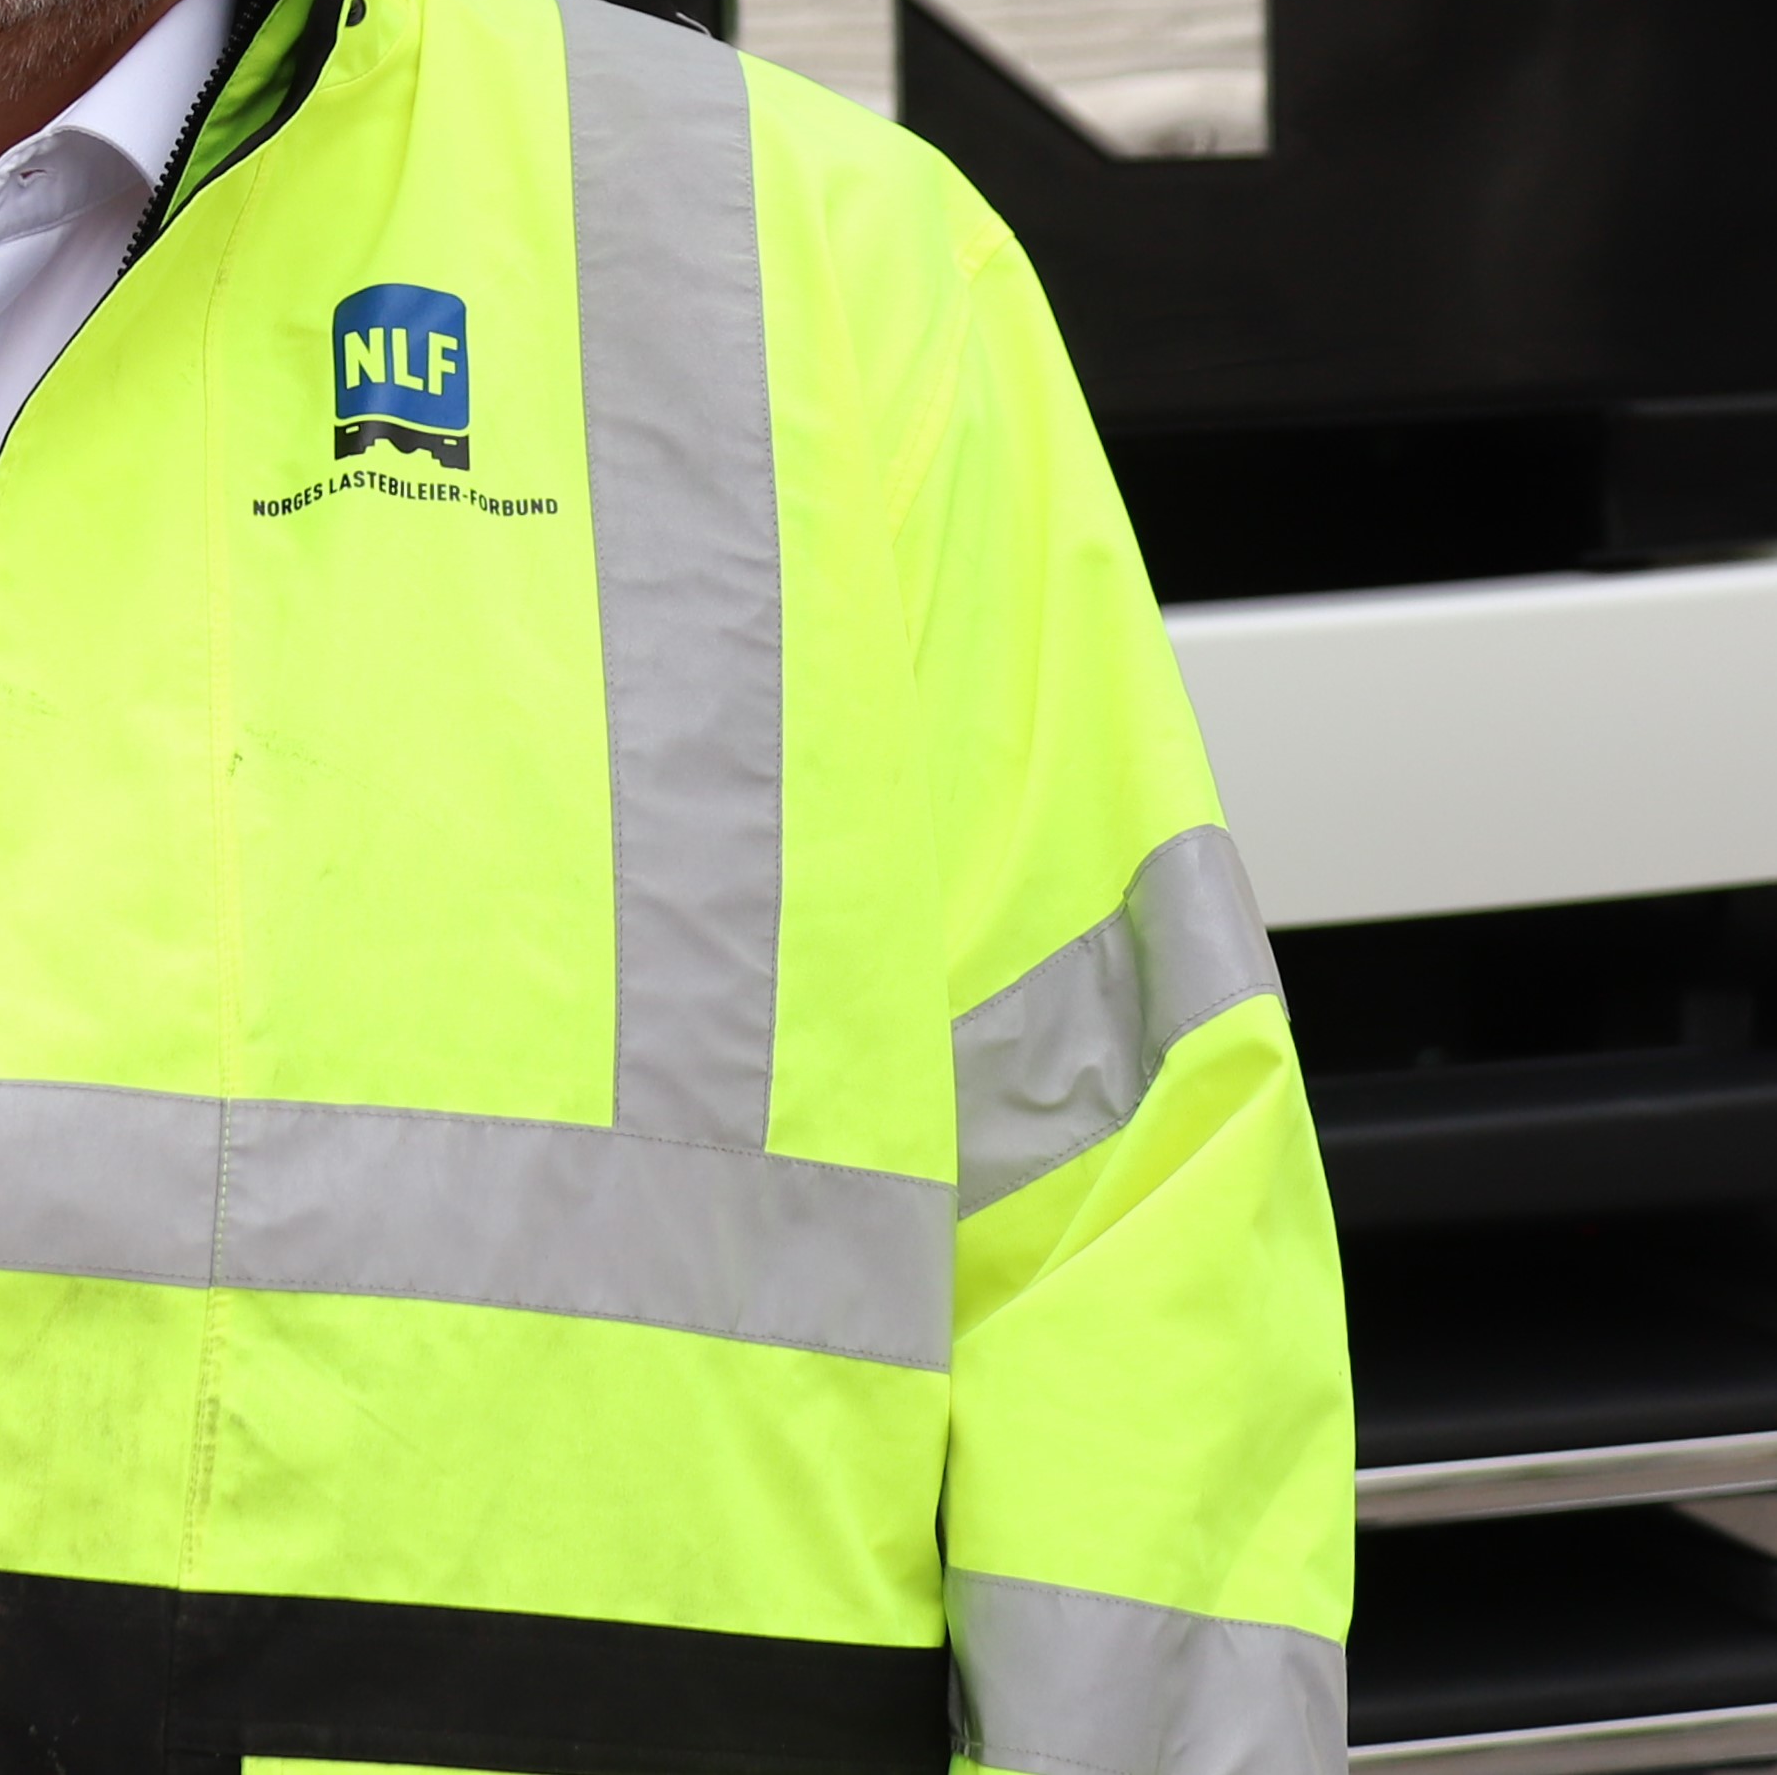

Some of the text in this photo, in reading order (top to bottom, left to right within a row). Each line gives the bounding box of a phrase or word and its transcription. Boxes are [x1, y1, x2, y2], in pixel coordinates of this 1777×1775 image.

[344, 327, 459, 397] NLF
[252, 470, 559, 517] NORGES LASTEBILEIER-FORBUND
